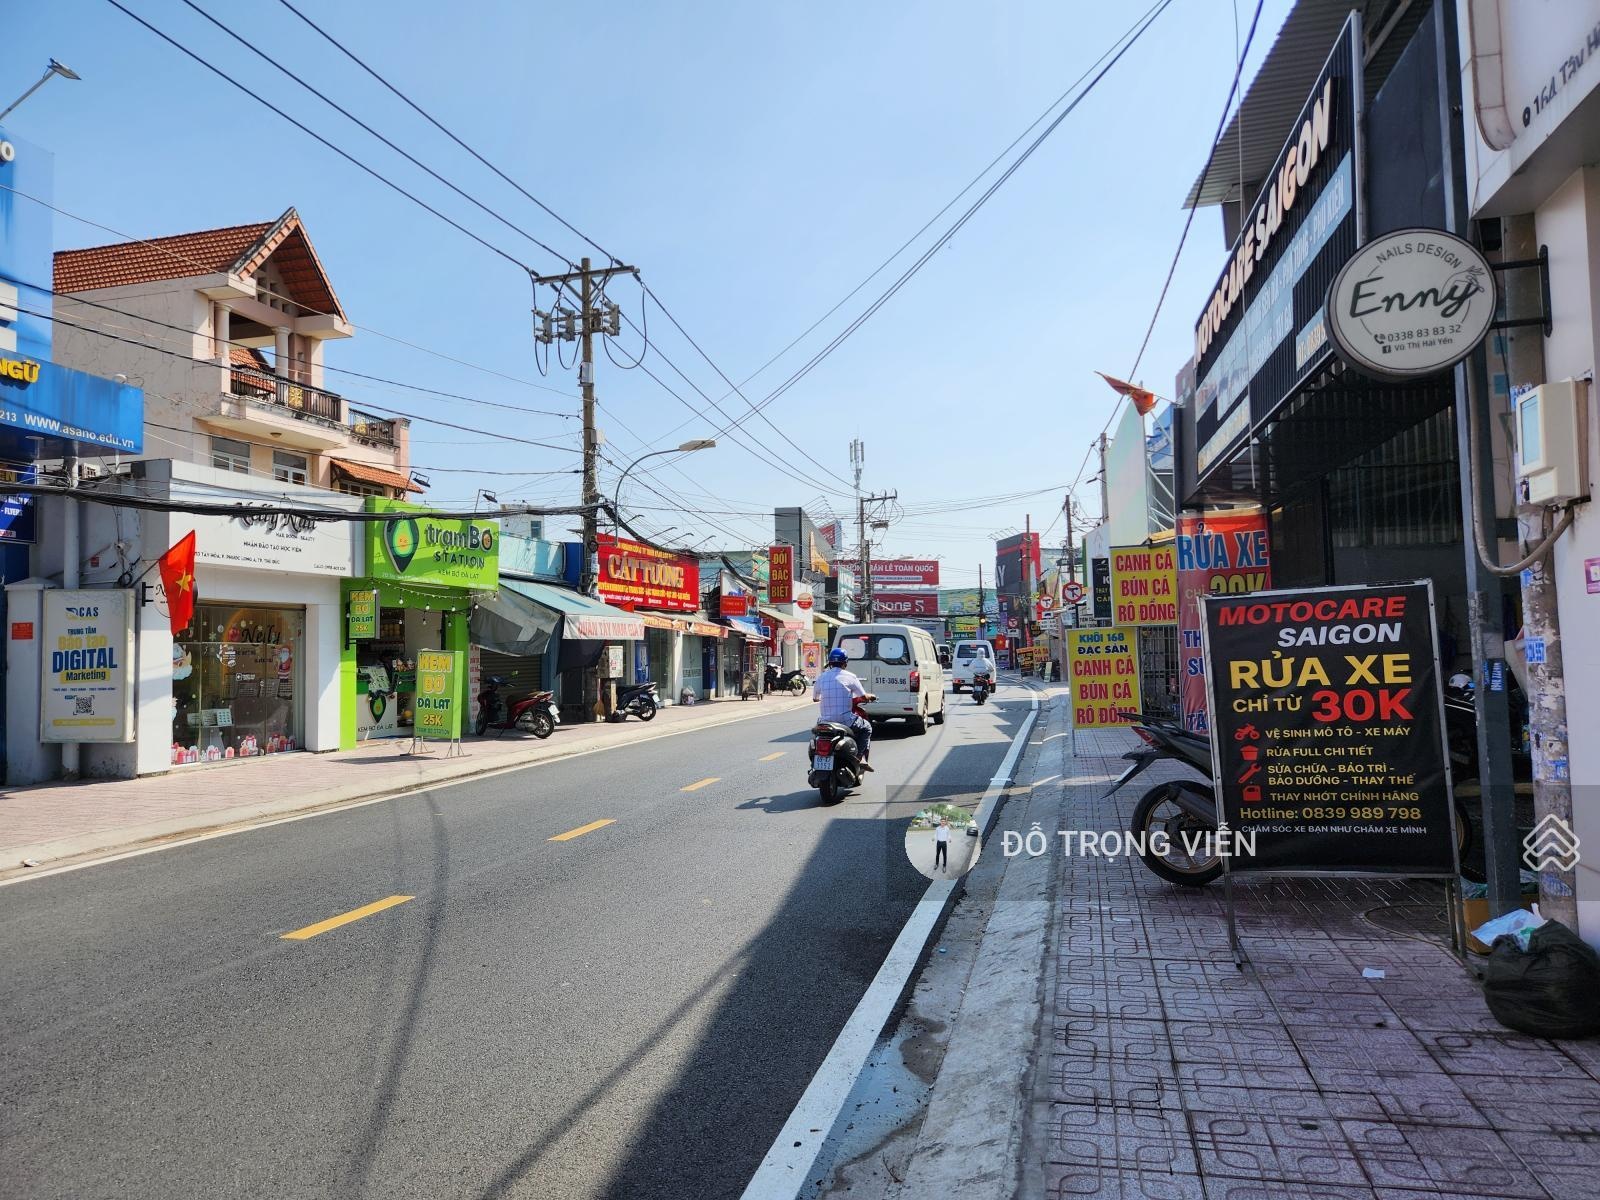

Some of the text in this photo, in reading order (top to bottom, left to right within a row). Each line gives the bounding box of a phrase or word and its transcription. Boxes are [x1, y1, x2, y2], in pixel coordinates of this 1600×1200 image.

[1255, 77, 1331, 261] SAIGON
[1376, 242, 1463, 269] NAILS DESIGN
[1349, 276, 1480, 318] Enny
[1387, 324, 1462, 343] 0338 83 83 32
[1177, 522, 1270, 572] RỬA XE
[434, 550, 485, 569] STATION
[607, 551, 640, 582] CÁT
[895, 562, 914, 572] TOÀN
[914, 562, 934, 573] QUỐC
[1115, 549, 1174, 573] CANH CÁ
[1121, 574, 1171, 597] BÚN CÁ
[80, 606, 99, 617] CAS
[1118, 600, 1136, 622] RÔ
[1139, 598, 1176, 621] ĐỒNG
[1219, 596, 1407, 626] MOTOCARE
[1106, 632, 1125, 643] 168
[1277, 622, 1403, 648] SAIGON
[52, 647, 118, 673] DIGITAL
[1073, 655, 1136, 677] CANH CÁ
[1229, 651, 1413, 689] RỬA XE
[65, 670, 106, 682] Marketing
[1079, 677, 1133, 700] BÚN CÁ
[433, 697, 451, 712] LẠT
[1076, 704, 1095, 724] RÔ
[1232, 688, 1414, 722] CHỈ TỪ 30K
[423, 713, 443, 727] 25K
[1265, 728, 1281, 739] VỆ
[1282, 728, 1311, 738] SINH
[1313, 727, 1334, 738] MÔ
[1336, 726, 1354, 737] TÔ
[1364, 727, 1381, 737] XE
[1383, 725, 1411, 737] MÁY
[1266, 744, 1374, 757] RỬA FULL CHI TIẾT
[1267, 763, 1292, 774] SỬA
[1293, 762, 1328, 774] CHỮA
[1338, 762, 1365, 773] BẢO
[1366, 763, 1387, 773] TRÌ
[1268, 774, 1294, 786] BẢO
[1295, 773, 1341, 786] DƯỠNG
[1351, 776, 1385, 786] THAY
[1388, 772, 1417, 785] THẾ
[1269, 792, 1300, 802] THAY
[1303, 790, 1337, 802] NHỚT
[1340, 789, 1379, 801] CHÍNH
[1239, 807, 1422, 820] Hotline: 0839 989 798
[1272, 823, 1293, 833] SÓC
[1294, 825, 1307, 833] XE
[1308, 825, 1329, 835] BẠN
[1330, 825, 1353, 833] NHƯ
[1385, 825, 1398, 834] XE
[1400, 824, 1427, 835] MÌNH
